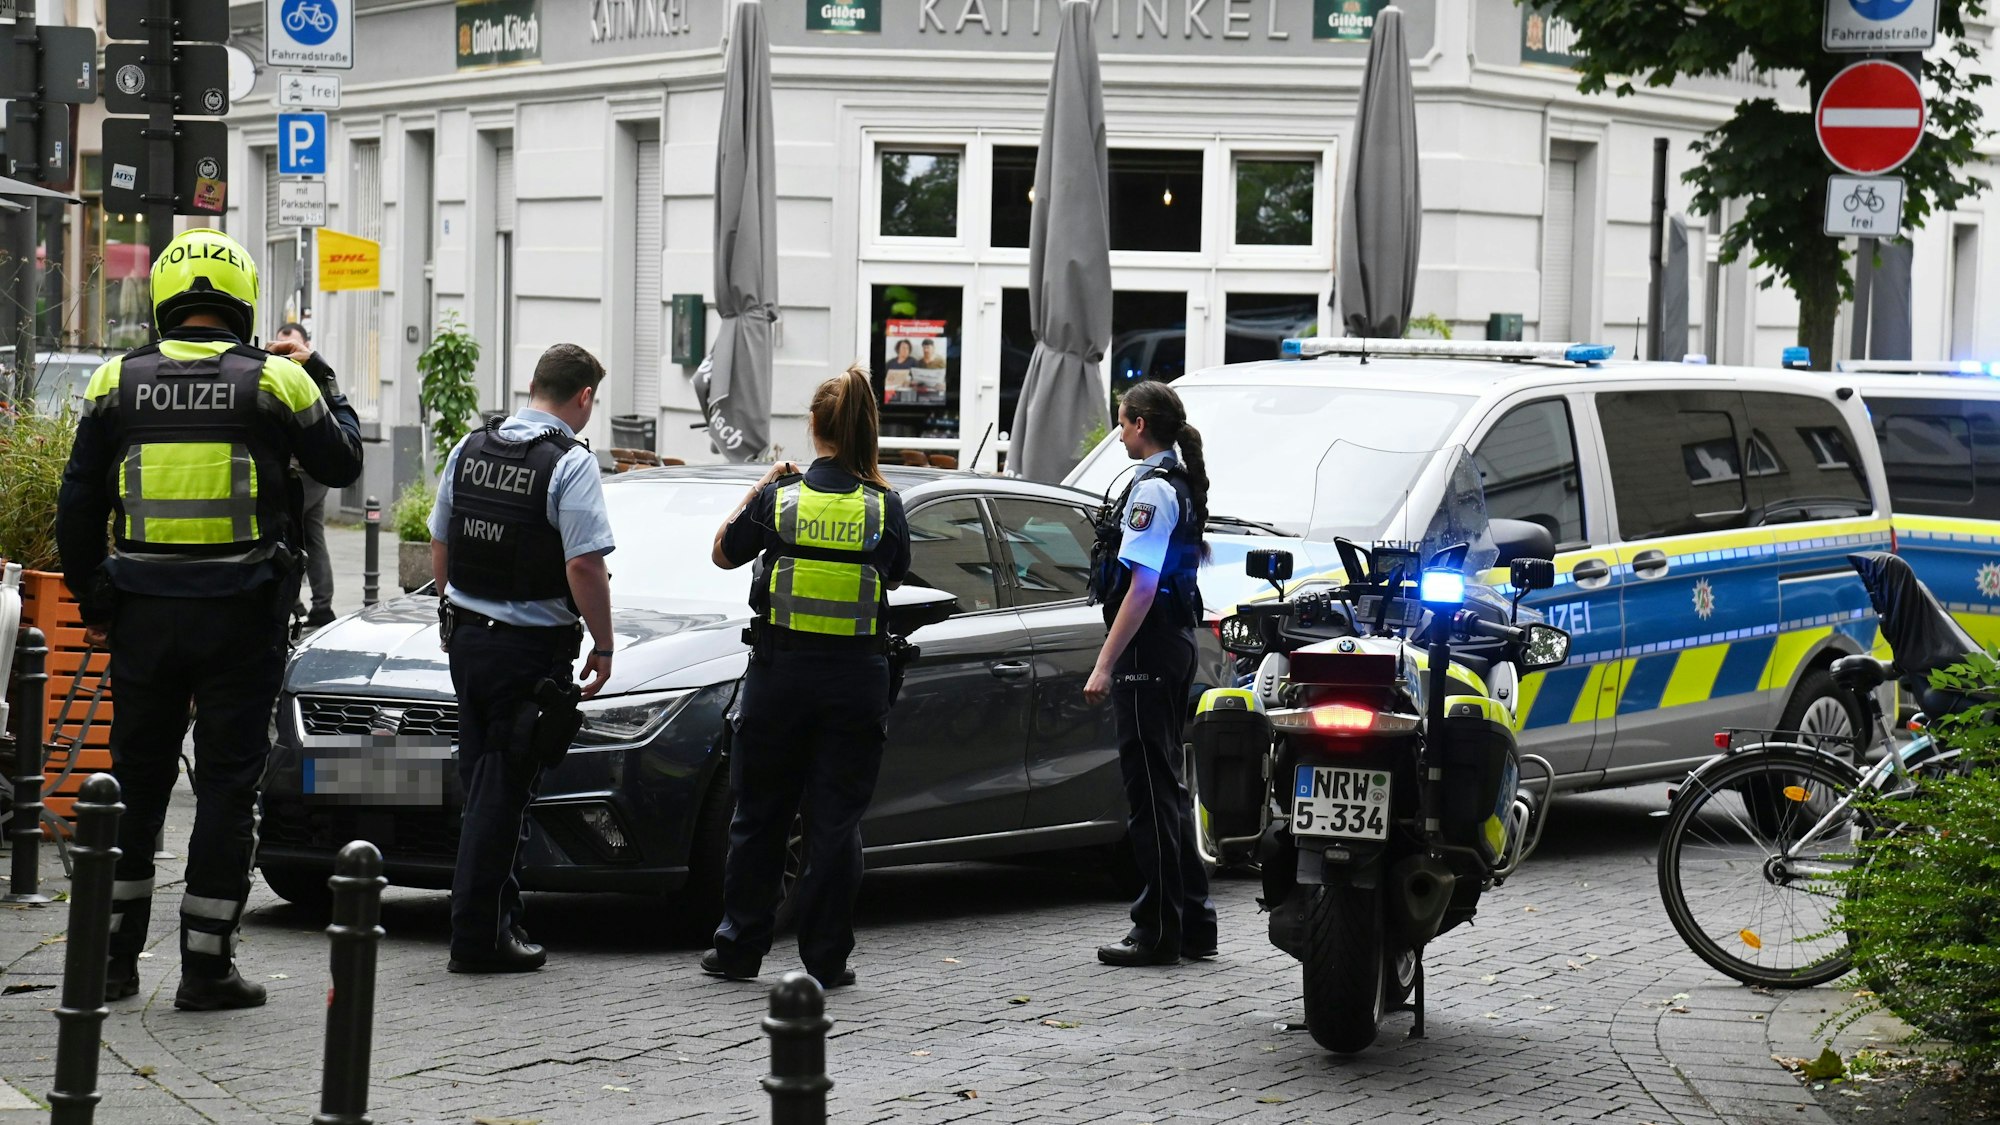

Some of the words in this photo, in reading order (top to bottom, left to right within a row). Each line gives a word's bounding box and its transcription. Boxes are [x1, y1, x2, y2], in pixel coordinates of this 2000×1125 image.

[821, 4, 866, 19] Gilden
[918, 0, 1290, 39] KATTINKEL
[1328, 12, 1373, 27] Gilden
[472, 19, 503, 55] Gilden
[1831, 26, 1928, 40] Fahrradstraße
[271, 49, 348, 62] Fahrradstraße
[312, 84, 336, 98] frei
[289, 120, 315, 167] P
[281, 199, 323, 208] Parkschein
[296, 187, 308, 195] mit
[1851, 216, 1873, 229] frei
[161, 243, 245, 273] POLIZEI
[329, 254, 367, 263] DHL
[135, 383, 236, 411] POLIZEI
[710, 406, 743, 450] lsch
[461, 457, 537, 495] POLIZEI
[464, 517, 505, 543] NRW
[797, 518, 864, 543] POLIZEI
[1548, 601, 1592, 636] IZEI
[1124, 673, 1149, 682] POLIZEI
[1313, 769, 1370, 802] NRW
